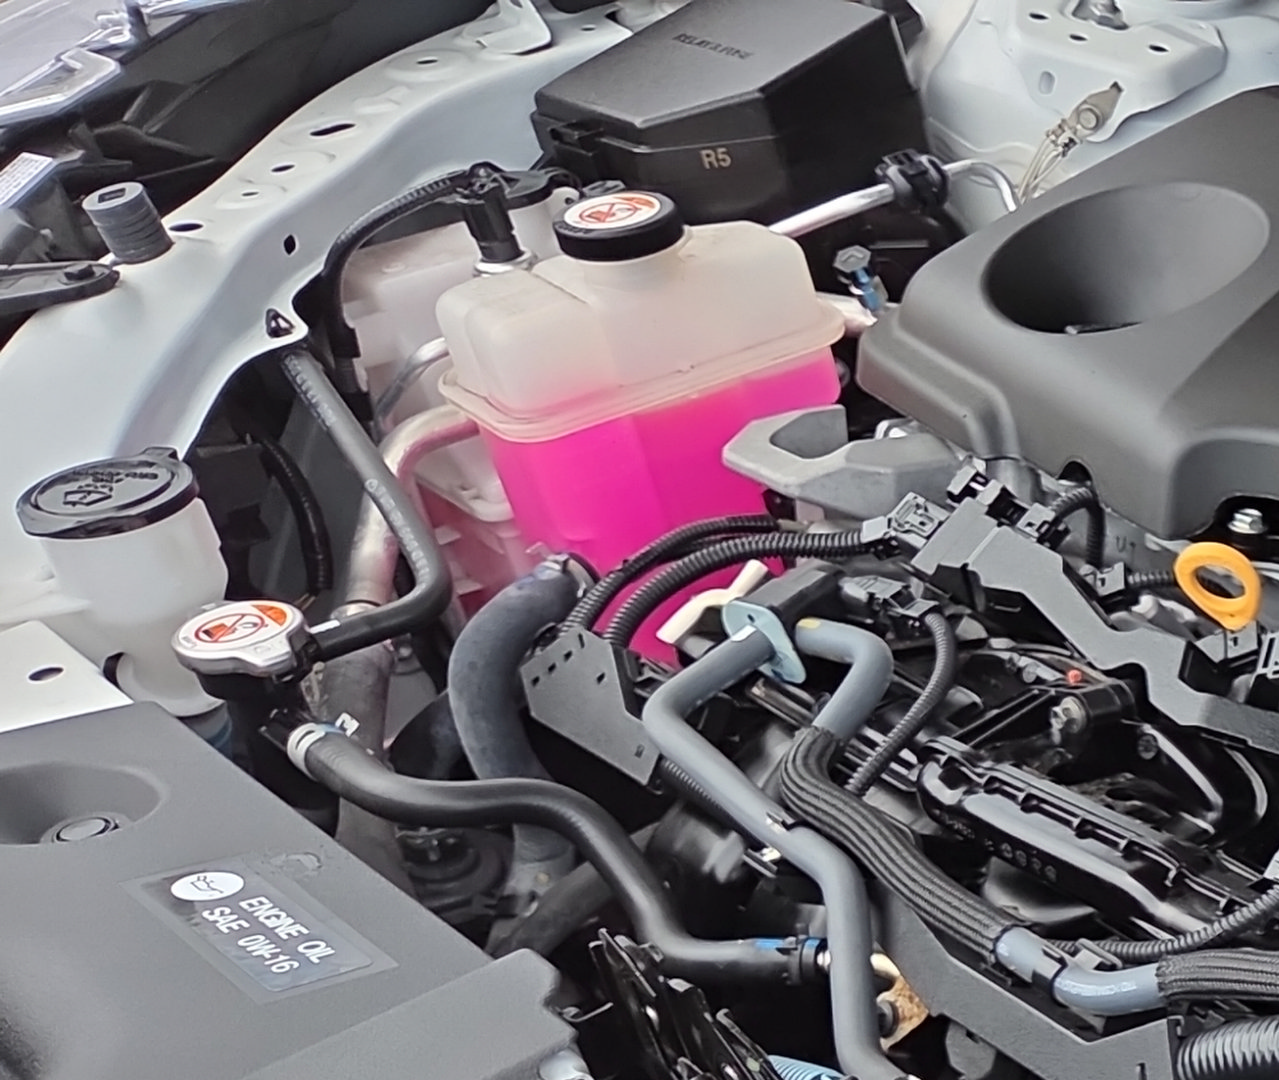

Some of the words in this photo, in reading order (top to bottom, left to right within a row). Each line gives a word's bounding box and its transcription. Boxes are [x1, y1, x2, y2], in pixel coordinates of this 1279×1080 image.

[699, 147, 732, 169] R5
[201, 906, 251, 934] SAE
[237, 934, 300, 974] 0W-16
[238, 896, 310, 940] ENGINE
[297, 940, 336, 964] OIL
